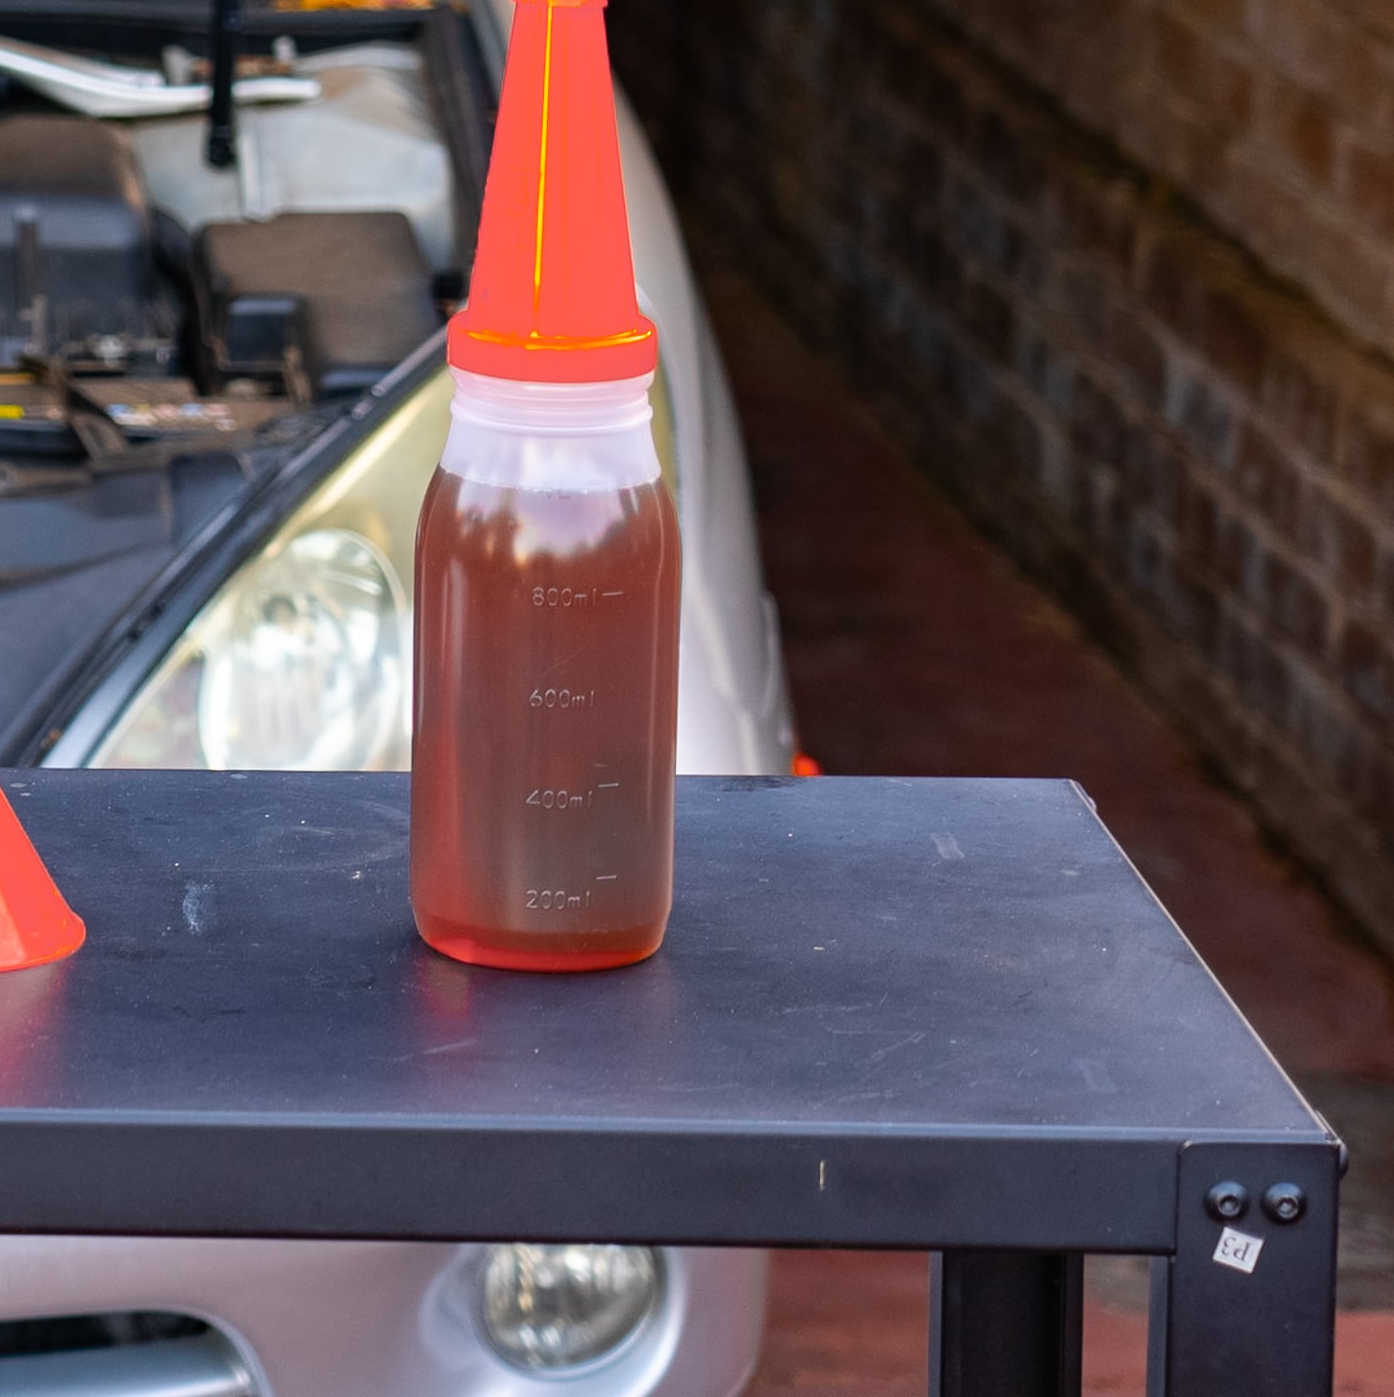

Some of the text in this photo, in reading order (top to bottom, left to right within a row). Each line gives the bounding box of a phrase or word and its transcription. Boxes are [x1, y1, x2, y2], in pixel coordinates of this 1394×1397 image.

[532, 586, 598, 607] 800ml
[528, 687, 595, 709] 600ml
[525, 789, 593, 810] 400ml
[525, 889, 591, 911] 200ml
